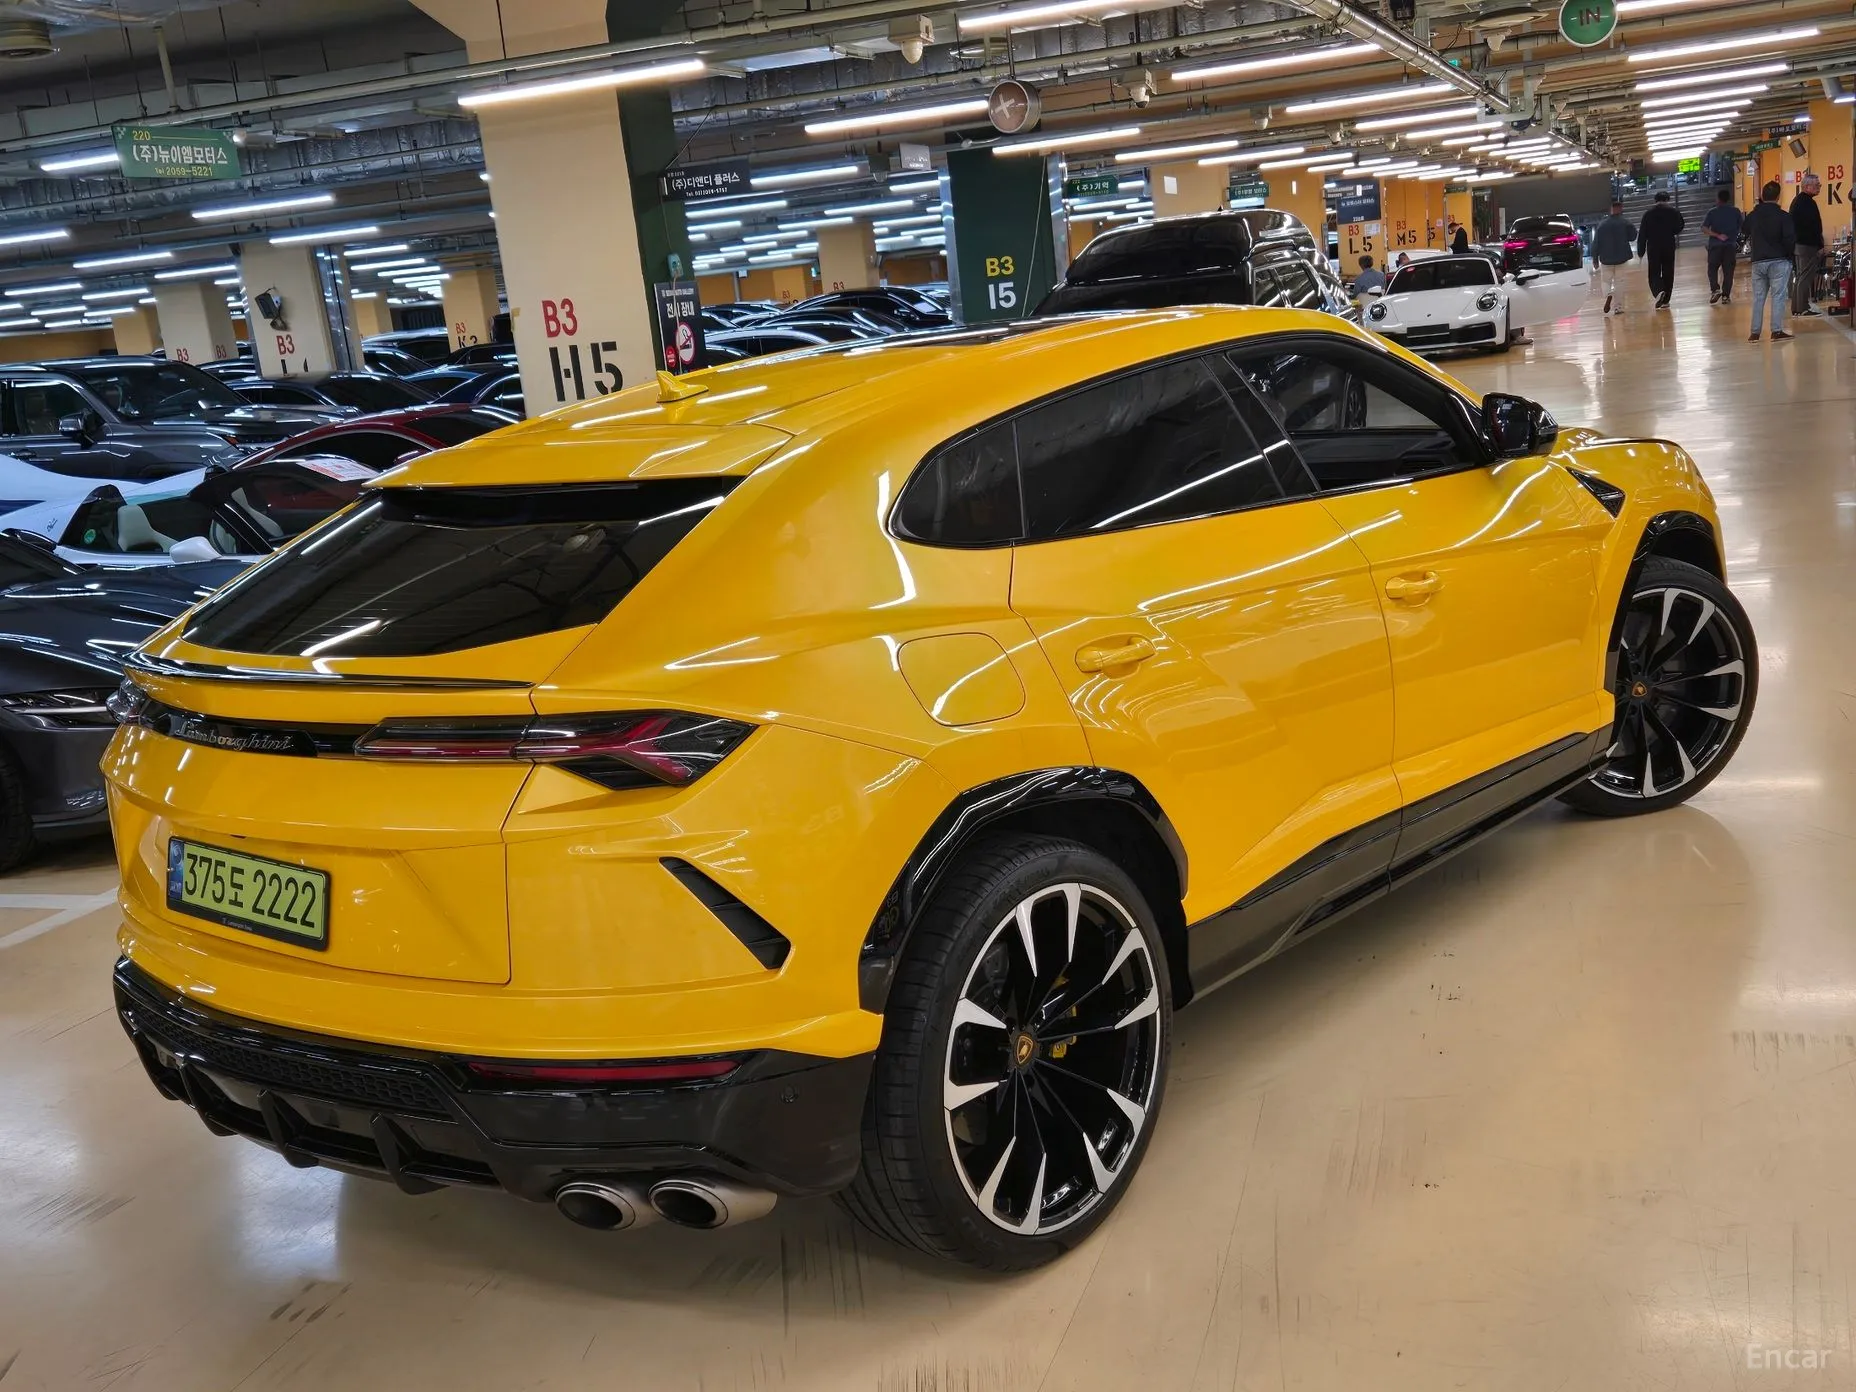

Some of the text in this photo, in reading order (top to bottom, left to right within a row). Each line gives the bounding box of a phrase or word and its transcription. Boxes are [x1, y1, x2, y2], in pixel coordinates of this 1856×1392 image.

[1579, 6, 1601, 26] IN
[132, 130, 151, 141] 220
[132, 145, 228, 164] (주)뉴이엠모터스
[166, 166, 213, 177] 2059-5221
[714, 171, 741, 186] 플러스
[1827, 164, 1844, 181] B3
[1348, 224, 1360, 237] B3
[1396, 220, 1407, 230] B3
[1348, 236, 1373, 254] L5
[1396, 230, 1417, 246] M5
[985, 255, 1015, 277] B3
[541, 298, 578, 338] B3
[455, 321, 466, 334] B3
[215, 344, 227, 359] B3
[276, 334, 295, 356] B3
[176, 348, 189, 362] B3
[174, 720, 294, 751] Lamborghini
[184, 852, 316, 929] 375도 2222
